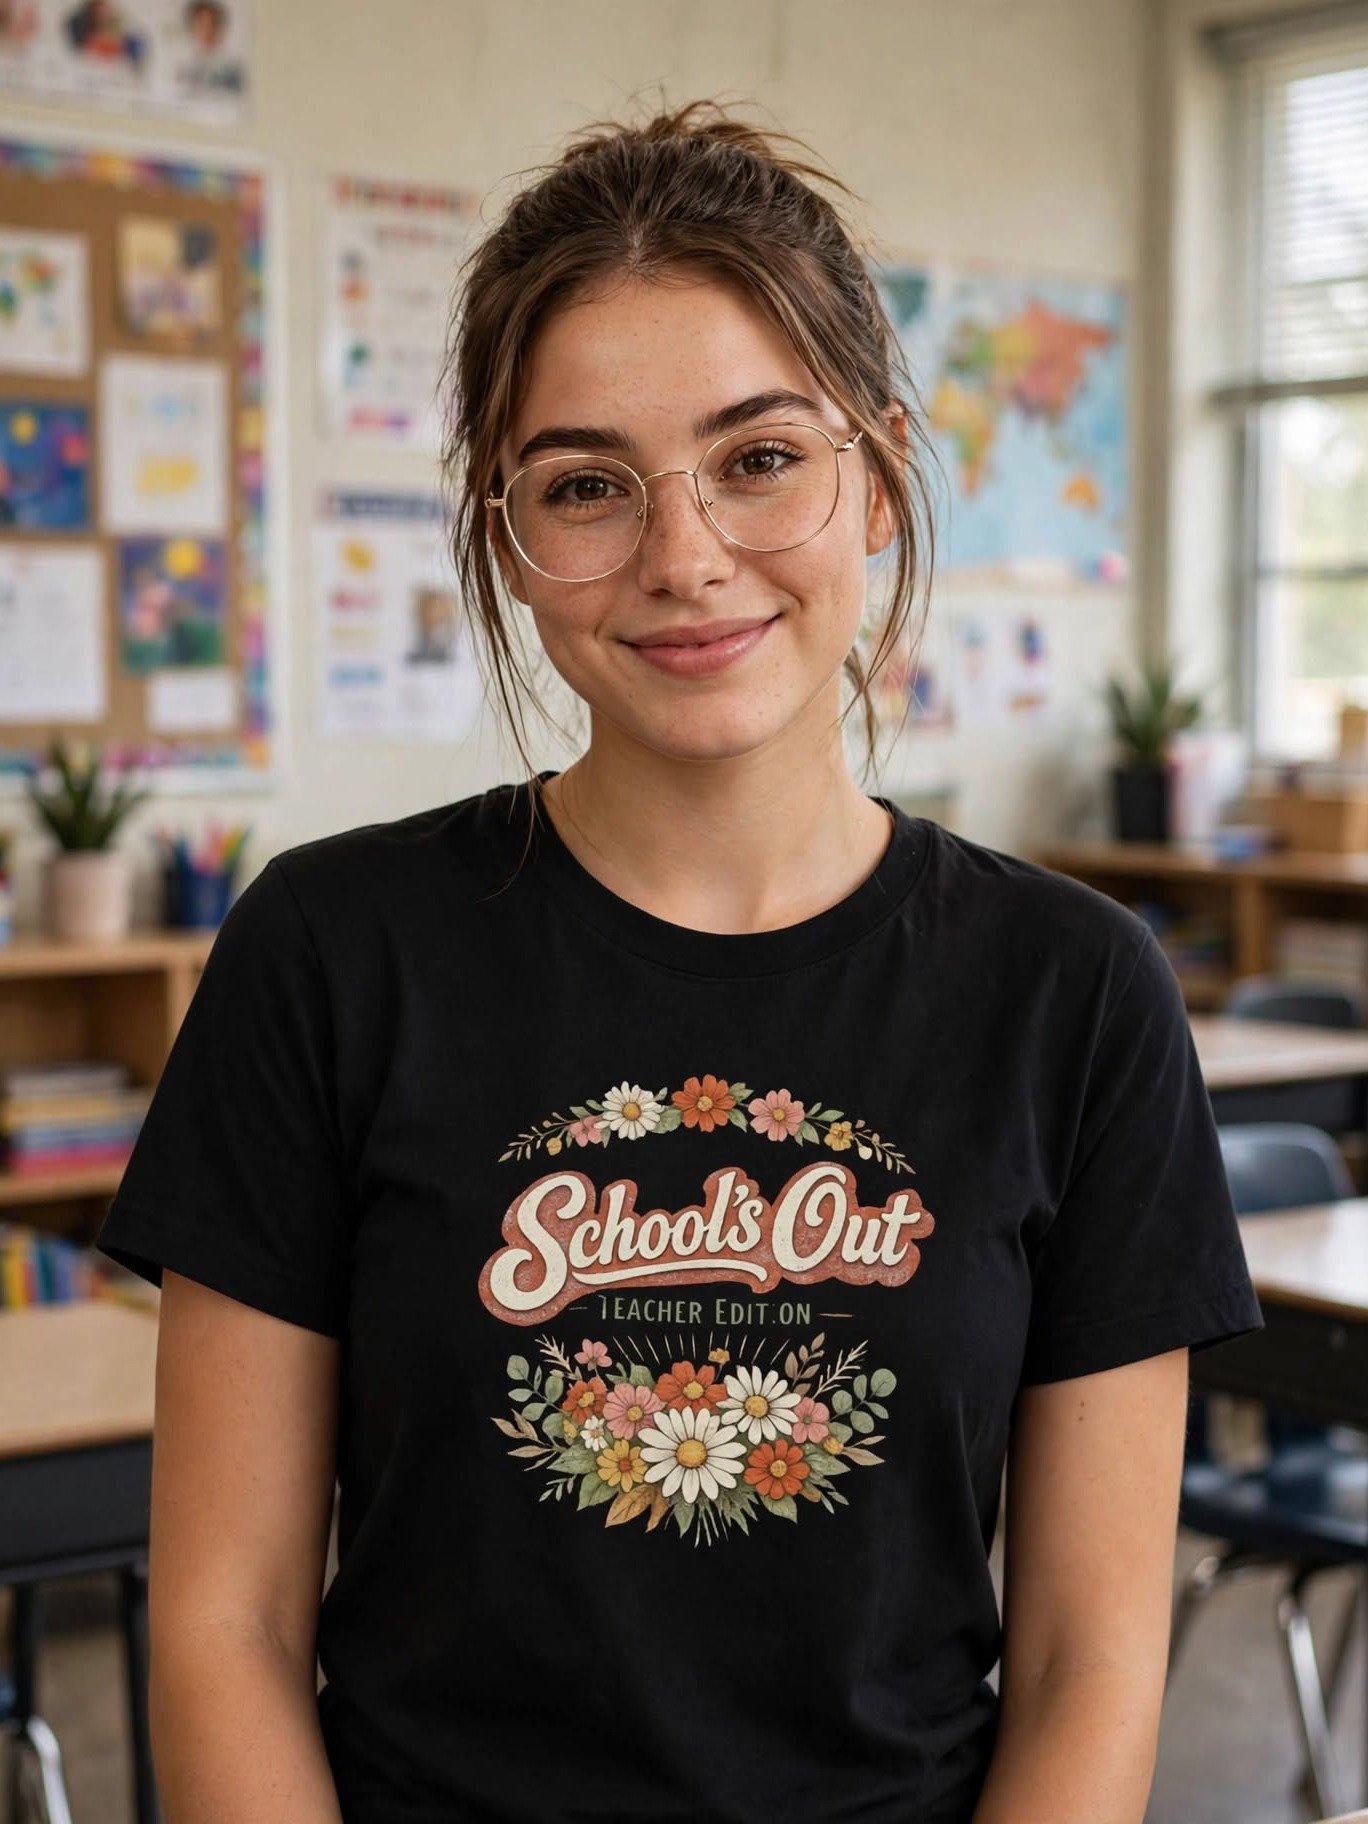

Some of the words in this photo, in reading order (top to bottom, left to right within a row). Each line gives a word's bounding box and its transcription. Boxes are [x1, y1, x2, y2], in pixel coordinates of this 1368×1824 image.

[489, 1171, 764, 1311] School's
[771, 1166, 921, 1272] Out
[598, 1294, 702, 1325] TEACHER
[715, 1298, 811, 1326] EDITON
